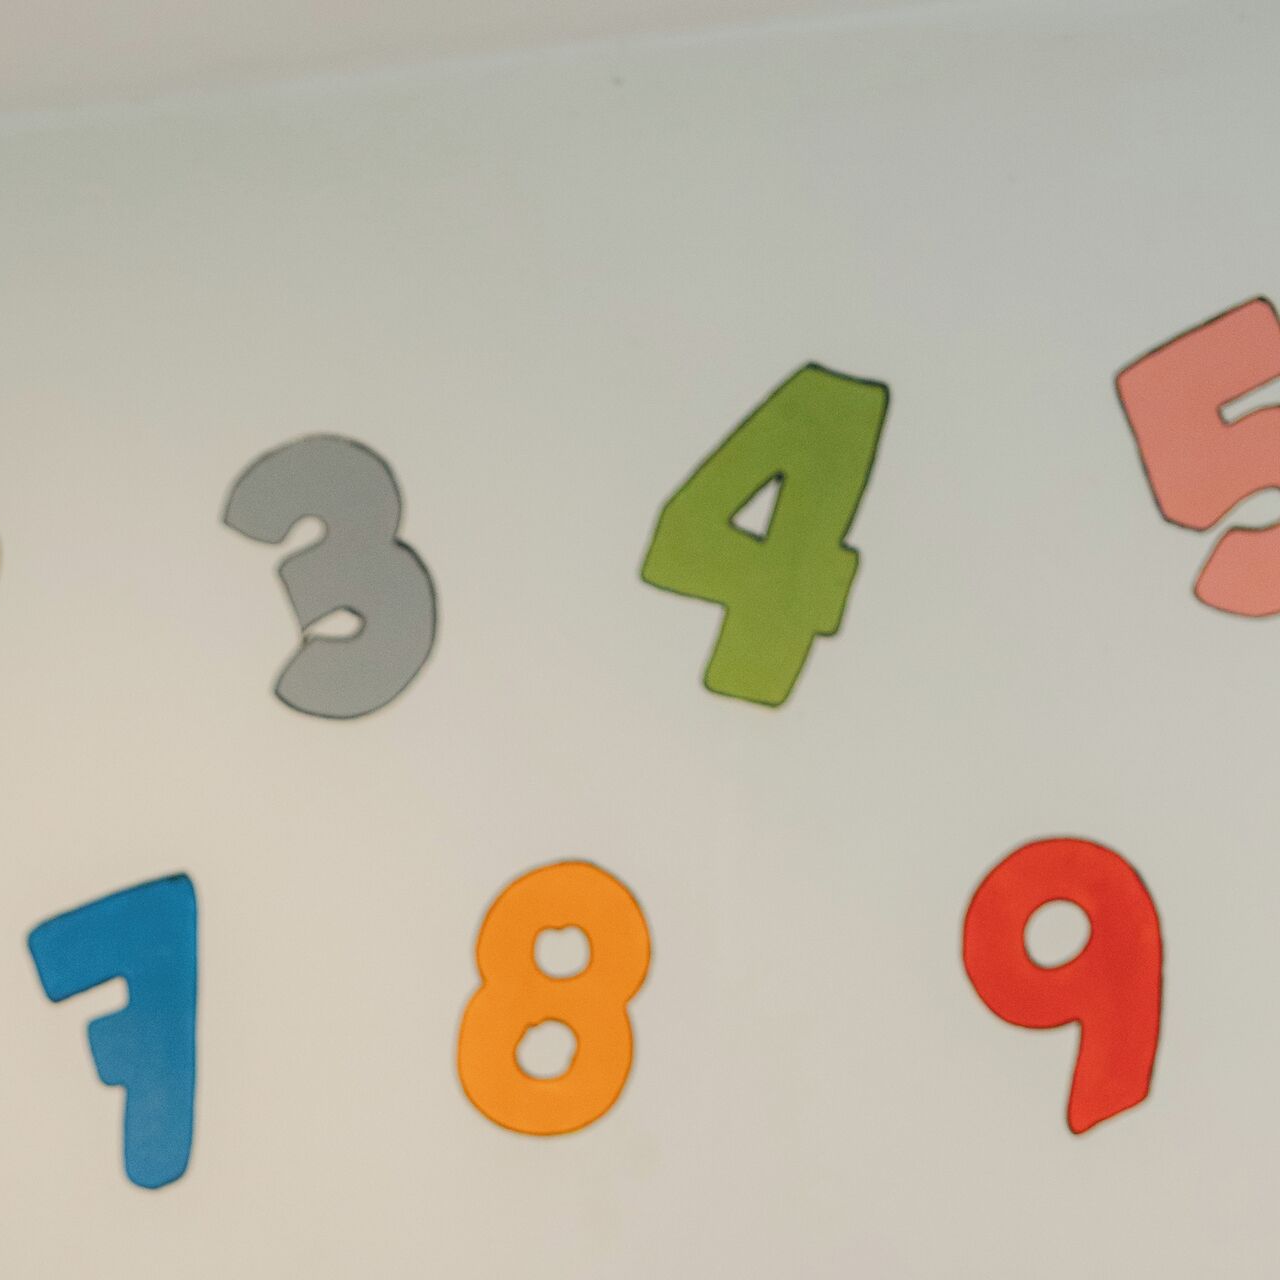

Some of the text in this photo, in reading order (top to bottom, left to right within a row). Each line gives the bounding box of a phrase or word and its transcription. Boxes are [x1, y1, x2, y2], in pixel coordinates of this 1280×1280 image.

[222, 433, 439, 721] 3
[639, 361, 891, 709] 4
[1114, 295, 1280, 618] 5
[26, 871, 199, 1191] 7
[456, 858, 652, 1138] 8
[961, 836, 1163, 1136] 9
